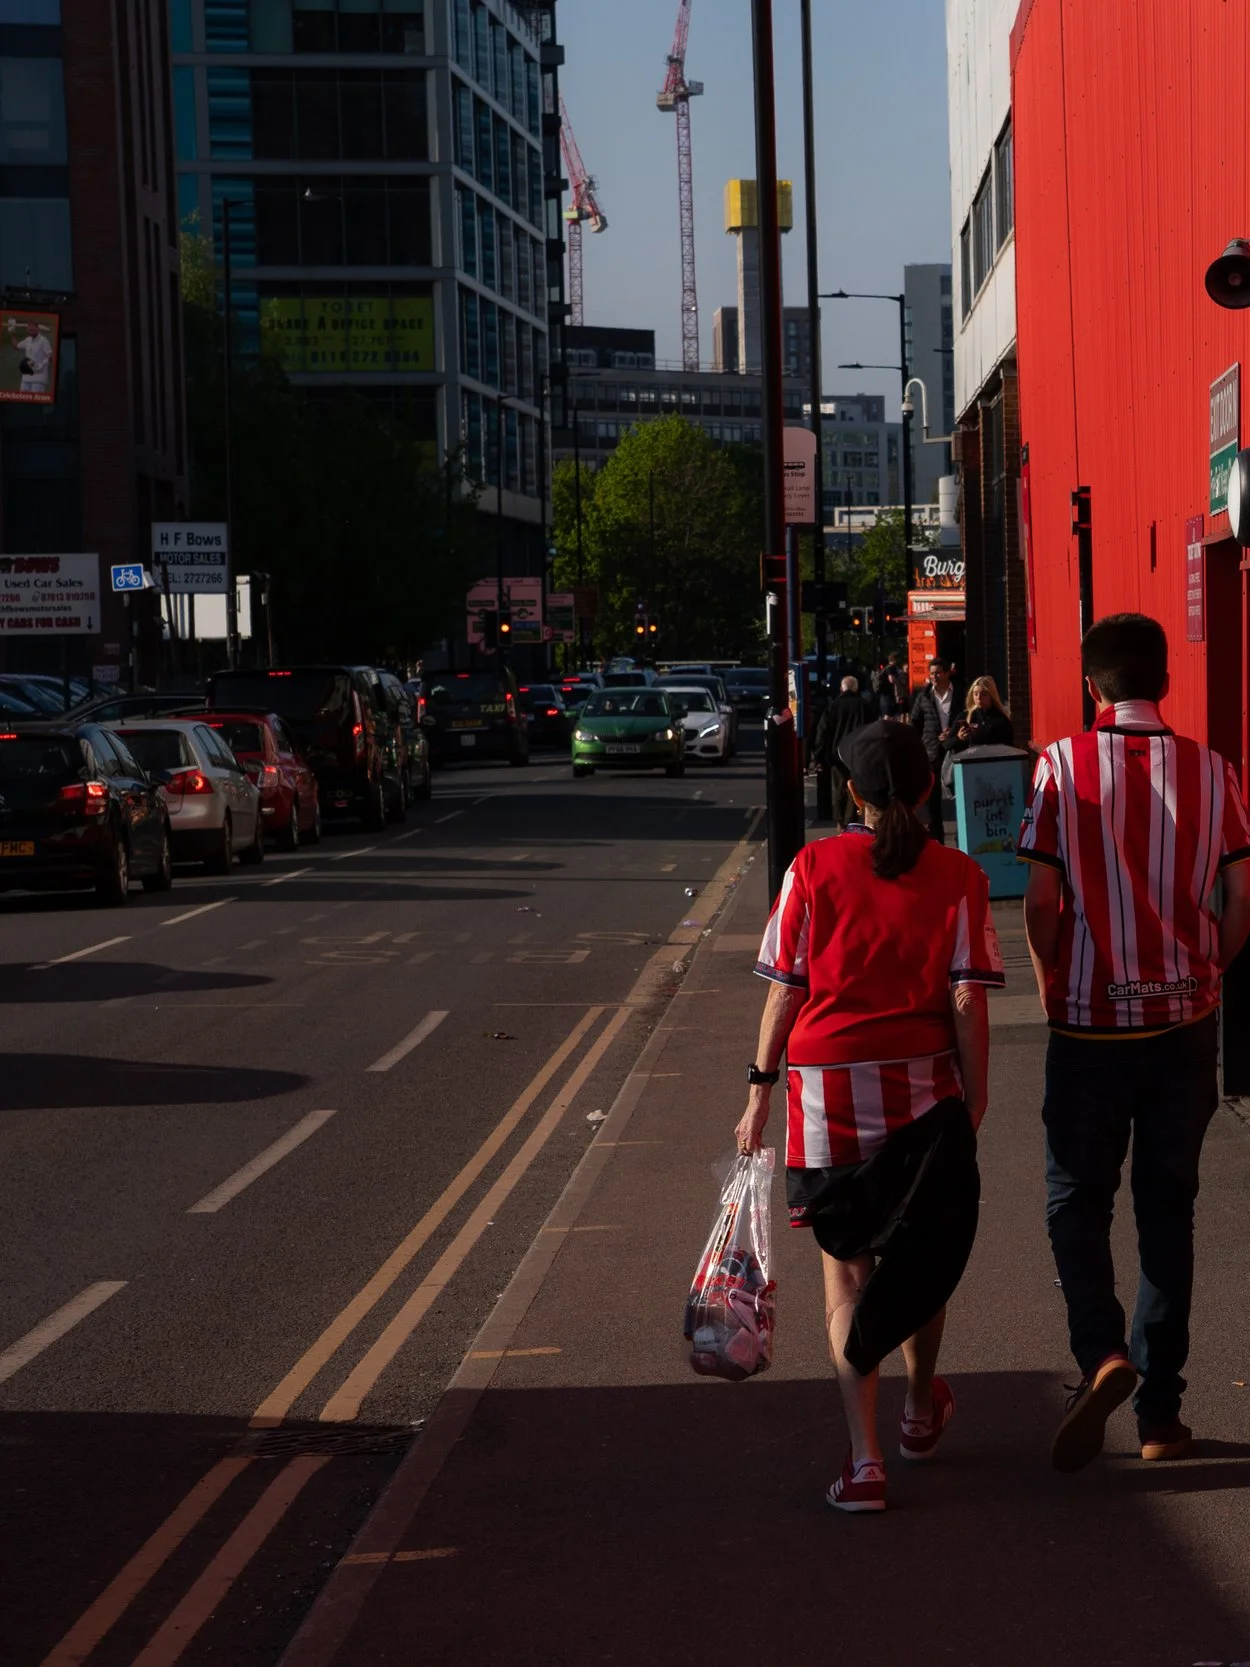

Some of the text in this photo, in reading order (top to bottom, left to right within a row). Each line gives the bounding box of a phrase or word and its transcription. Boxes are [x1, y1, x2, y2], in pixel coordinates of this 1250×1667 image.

[317, 315, 326, 330] A
[160, 531, 221, 546] H F Bows
[159, 552, 221, 564] MOTOR SALES
[923, 555, 966, 582] Burg
[4, 577, 84, 588] Used Car Sales
[183, 572, 223, 584] 2727266
[480, 703, 506, 713] TAXI
[985, 823, 1008, 837] bin
[1107, 980, 1188, 996] CarMats.co.uk
